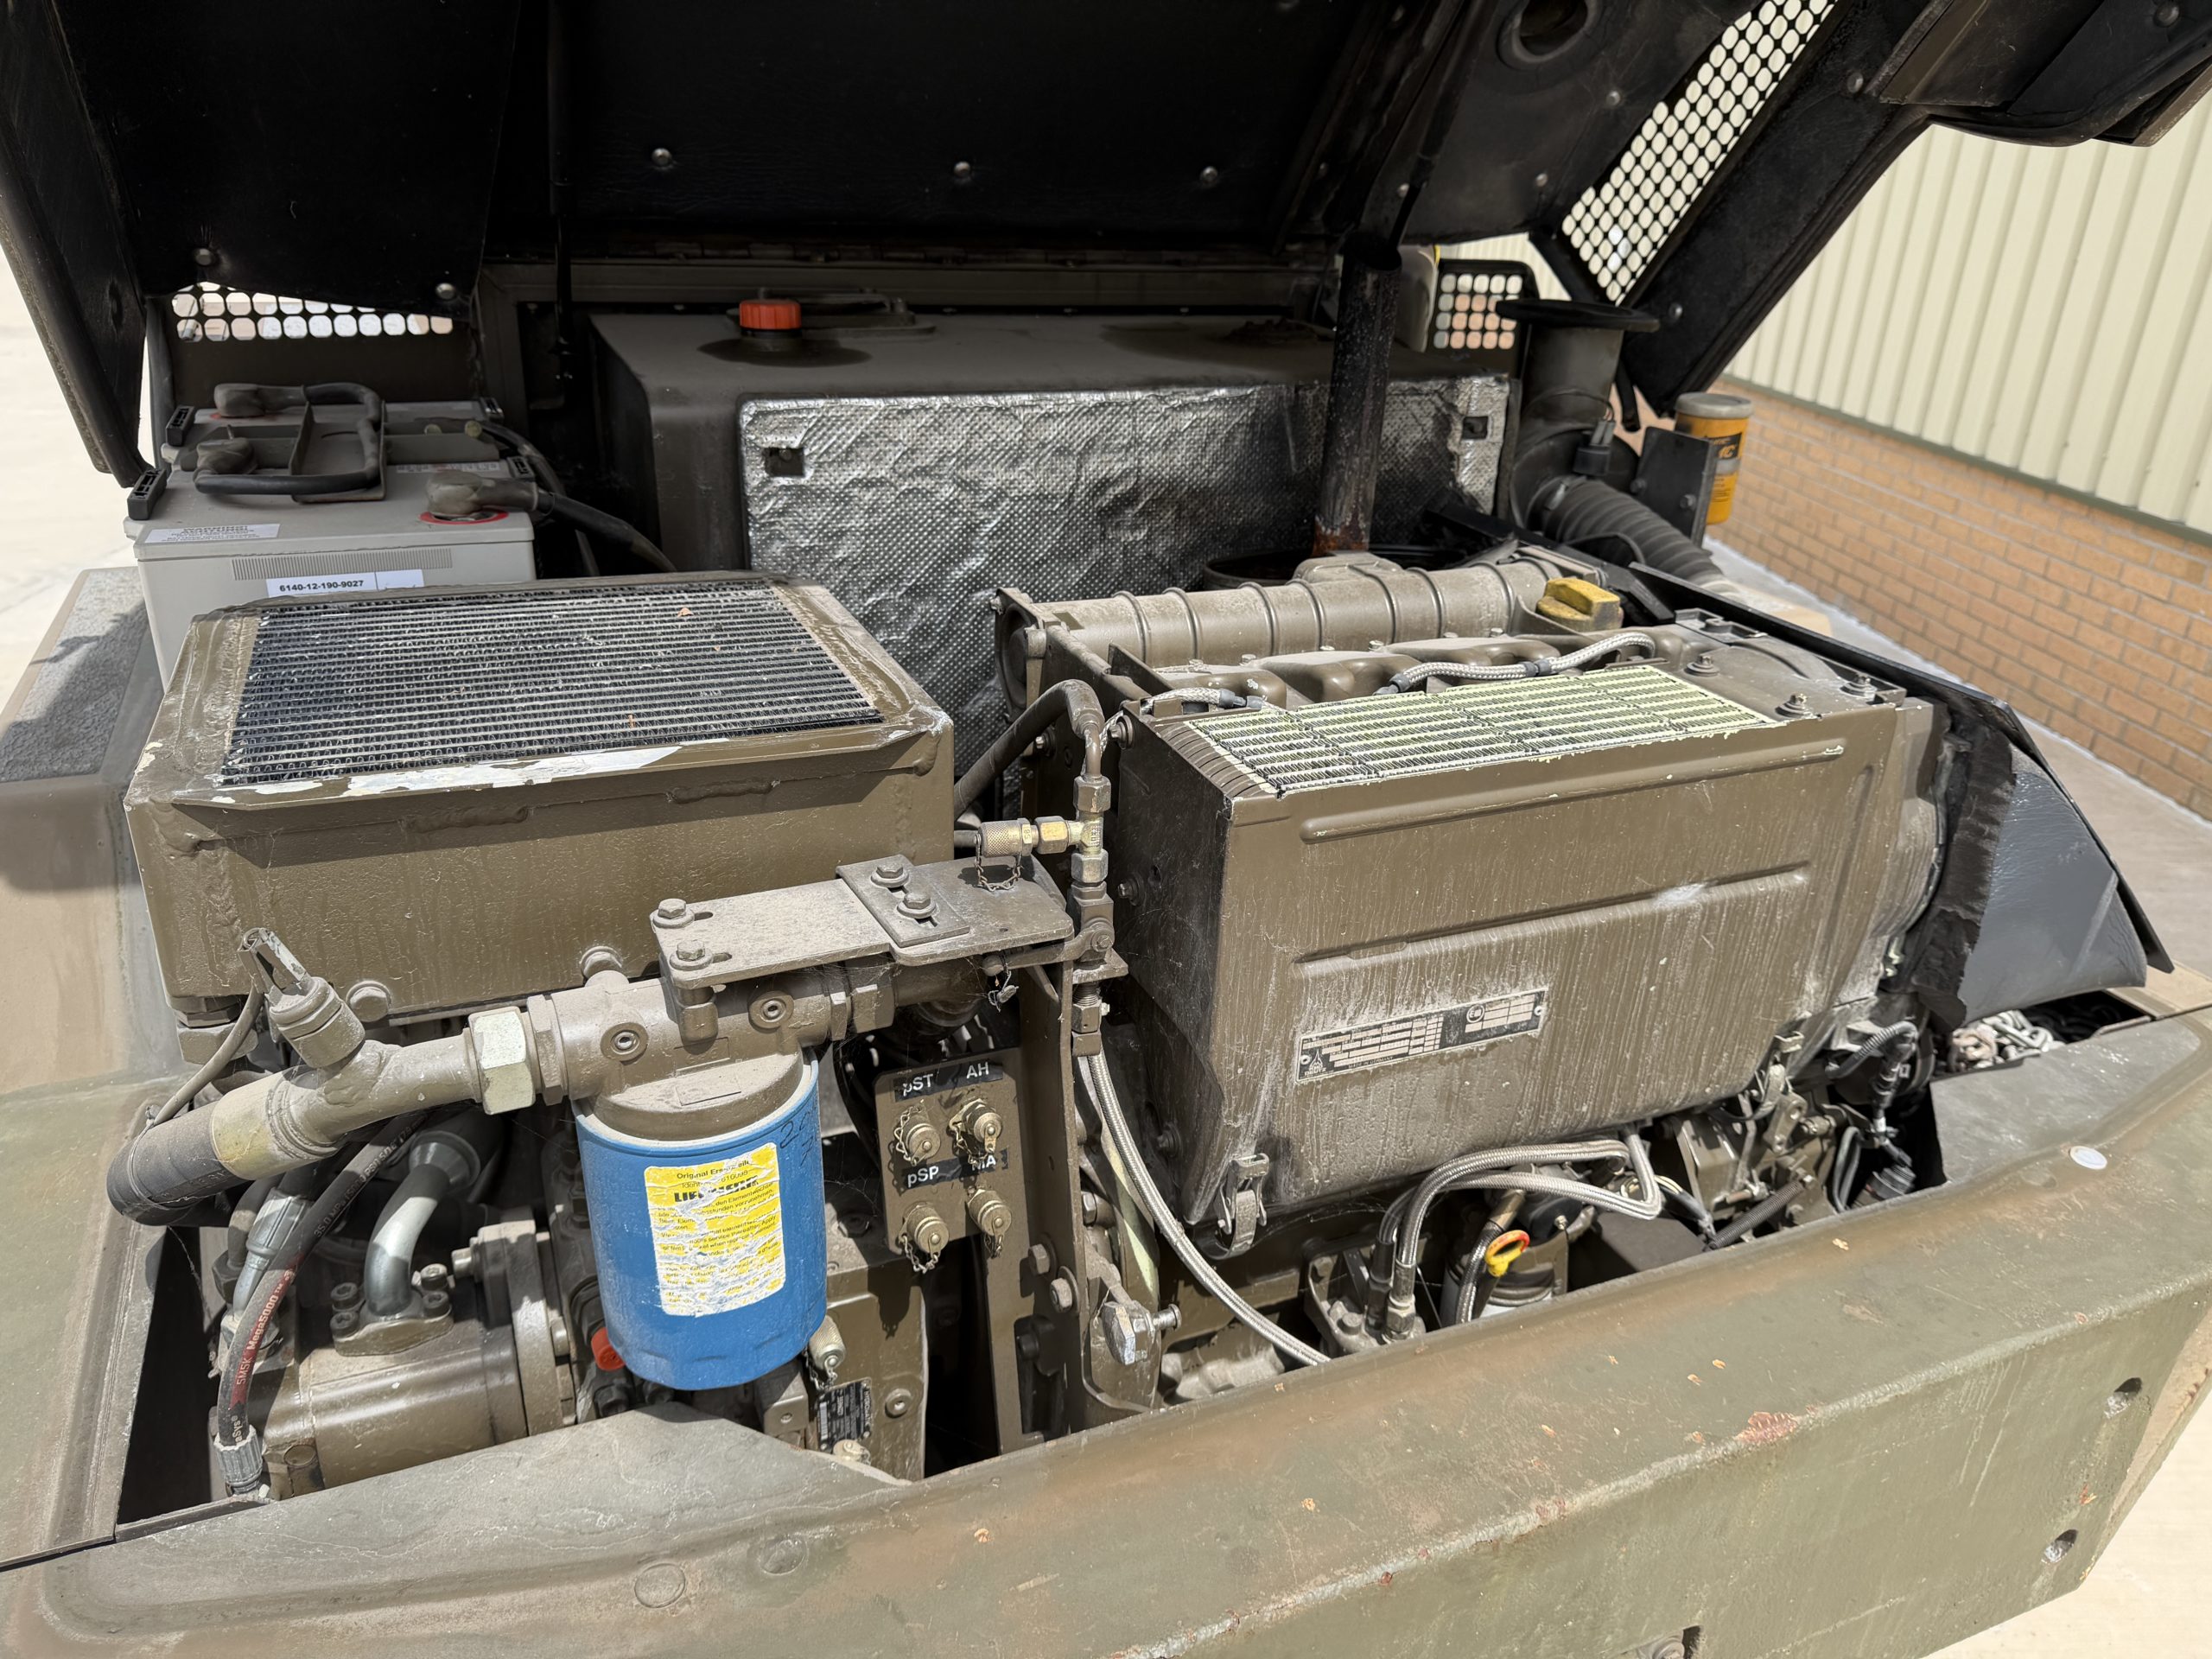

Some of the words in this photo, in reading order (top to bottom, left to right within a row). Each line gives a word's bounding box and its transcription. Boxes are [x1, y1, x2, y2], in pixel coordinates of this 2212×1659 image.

[279, 580, 365, 592] 6140-12-190-9027
[966, 1061, 990, 1079] AH
[907, 1166, 939, 1188] pSP
[237, 1356, 253, 1385] 5M5K
